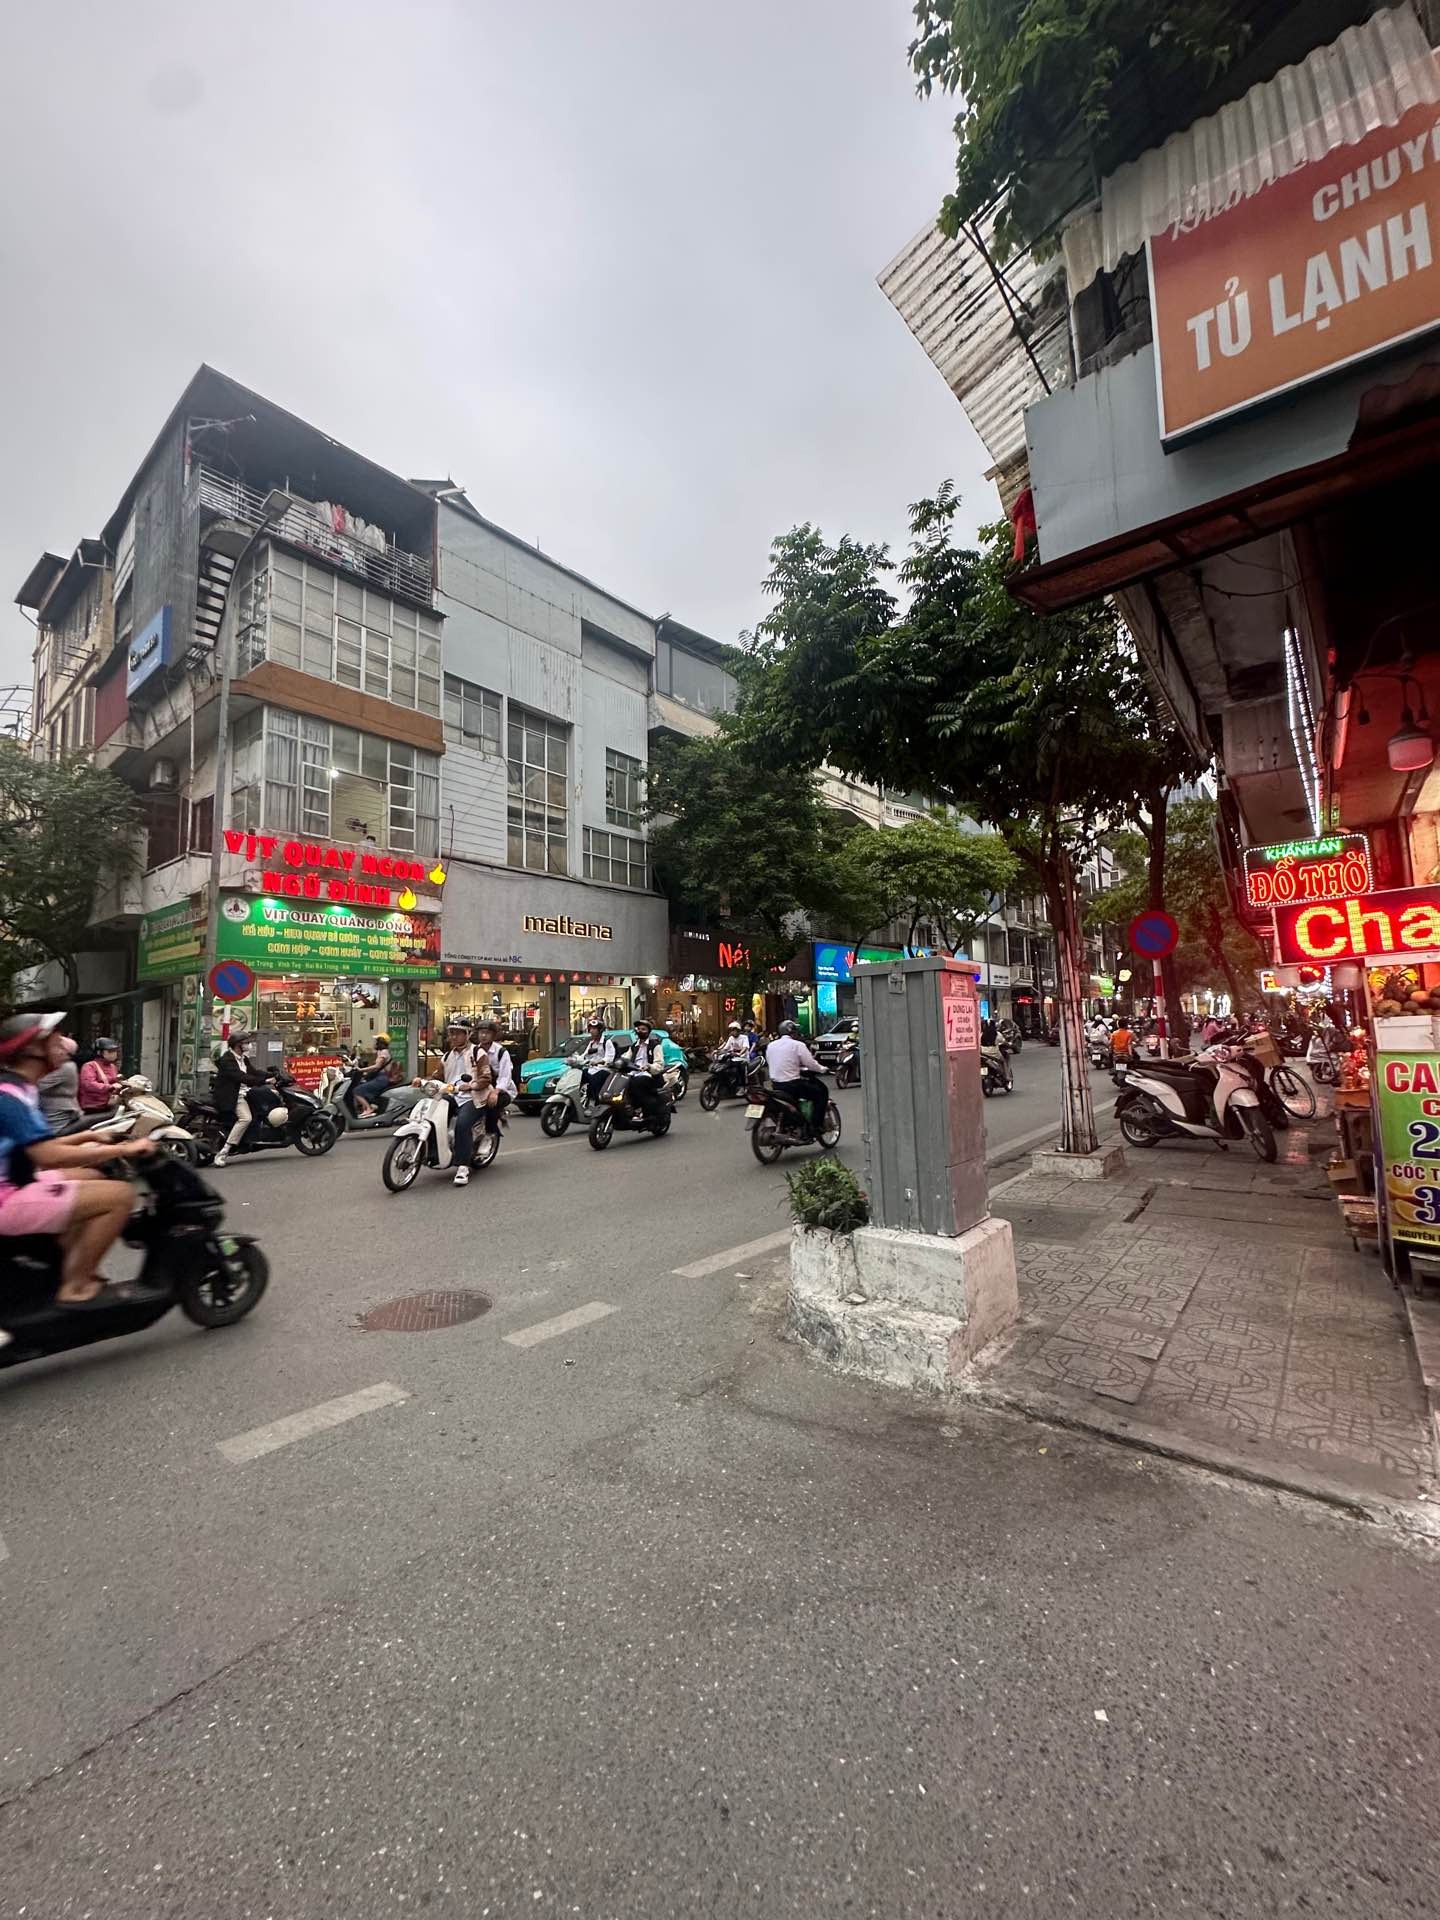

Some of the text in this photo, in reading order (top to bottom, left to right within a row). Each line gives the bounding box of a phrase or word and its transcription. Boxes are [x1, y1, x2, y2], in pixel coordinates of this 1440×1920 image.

[1186, 202, 1433, 371] TỦ LẠNH
[224, 829, 425, 881] VỊT QUAY NGON
[1265, 840, 1341, 860] KHÁNH AN
[1299, 851, 1369, 899] THỜ
[263, 908, 289, 923] VỊT
[290, 911, 327, 926] QUAY
[329, 913, 378, 930] QUẢNG
[523, 914, 613, 941] mattana
[1385, 1060, 1440, 1094] CA
[1392, 1160, 1426, 1182] CỐC
